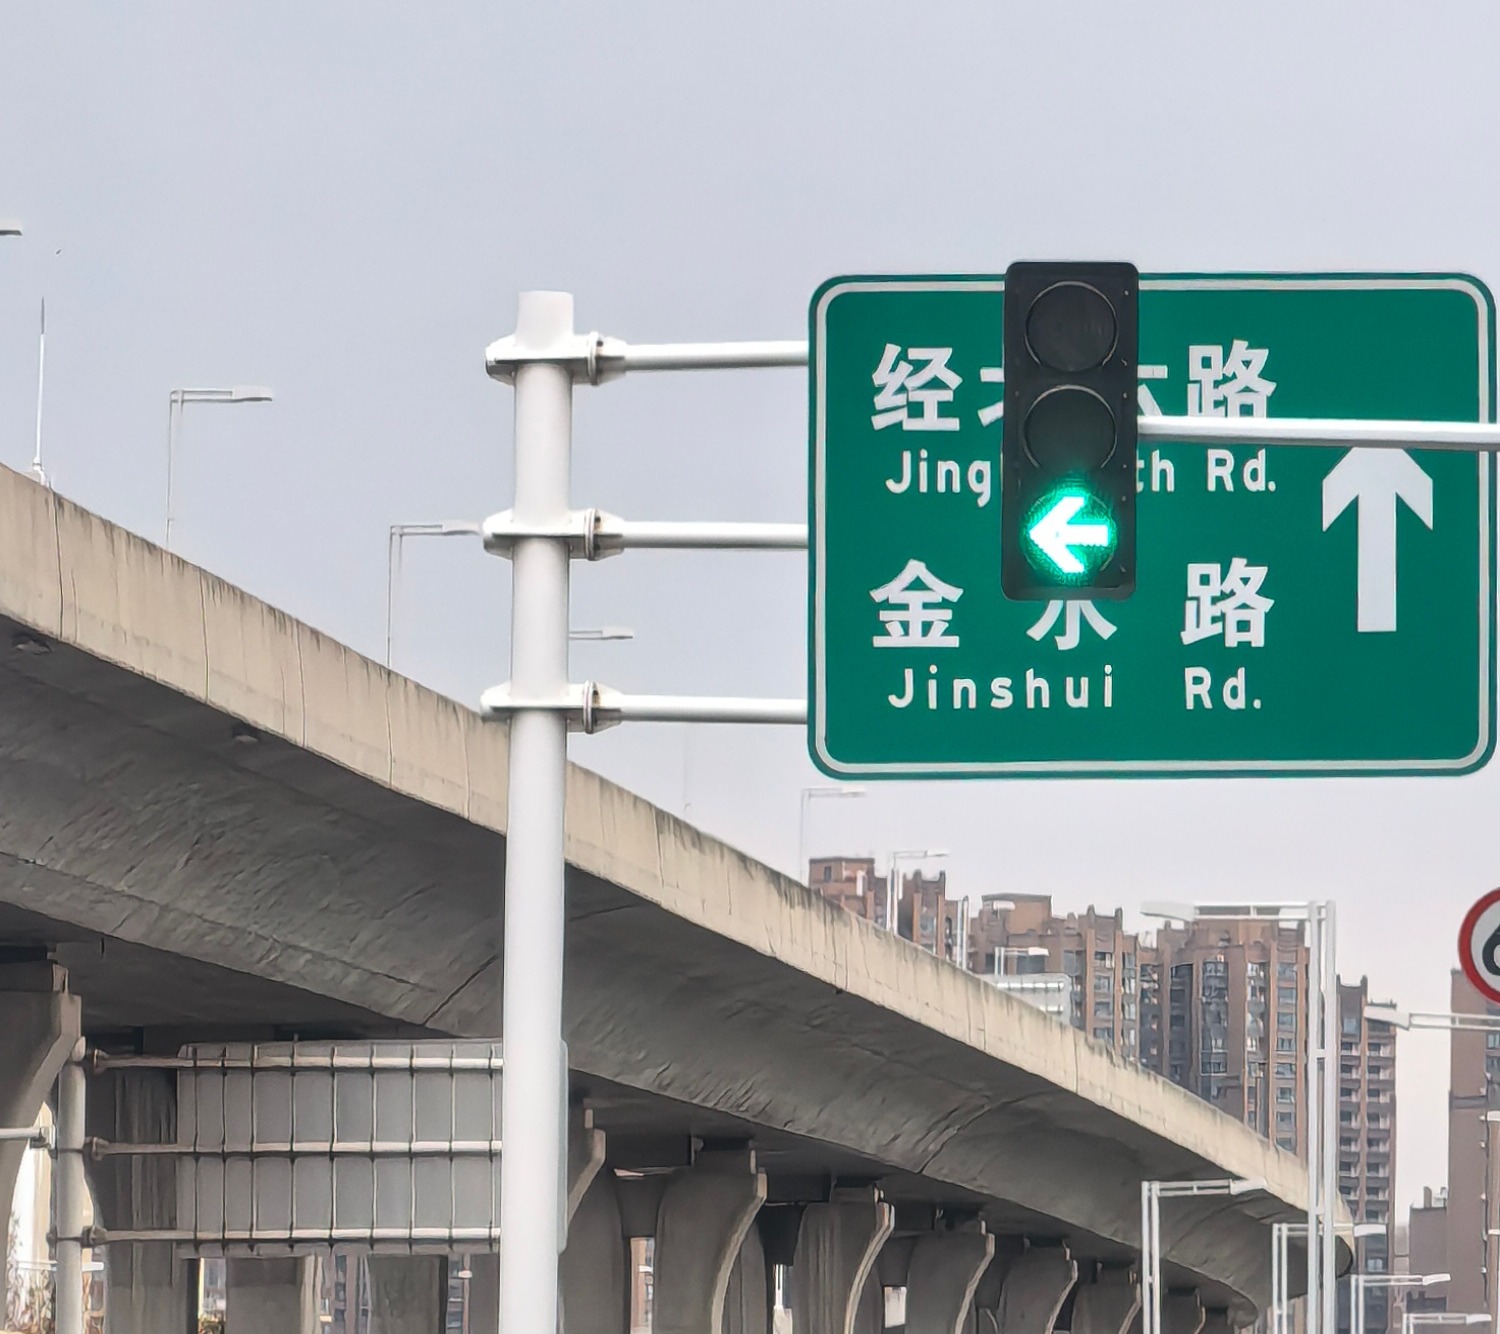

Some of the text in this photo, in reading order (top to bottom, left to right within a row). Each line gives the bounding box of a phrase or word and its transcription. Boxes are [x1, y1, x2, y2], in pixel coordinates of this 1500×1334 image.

[871, 340, 1278, 431] 经路
[1207, 448, 1277, 492] Rd.
[888, 665, 1262, 710] Jinshui Rd.
